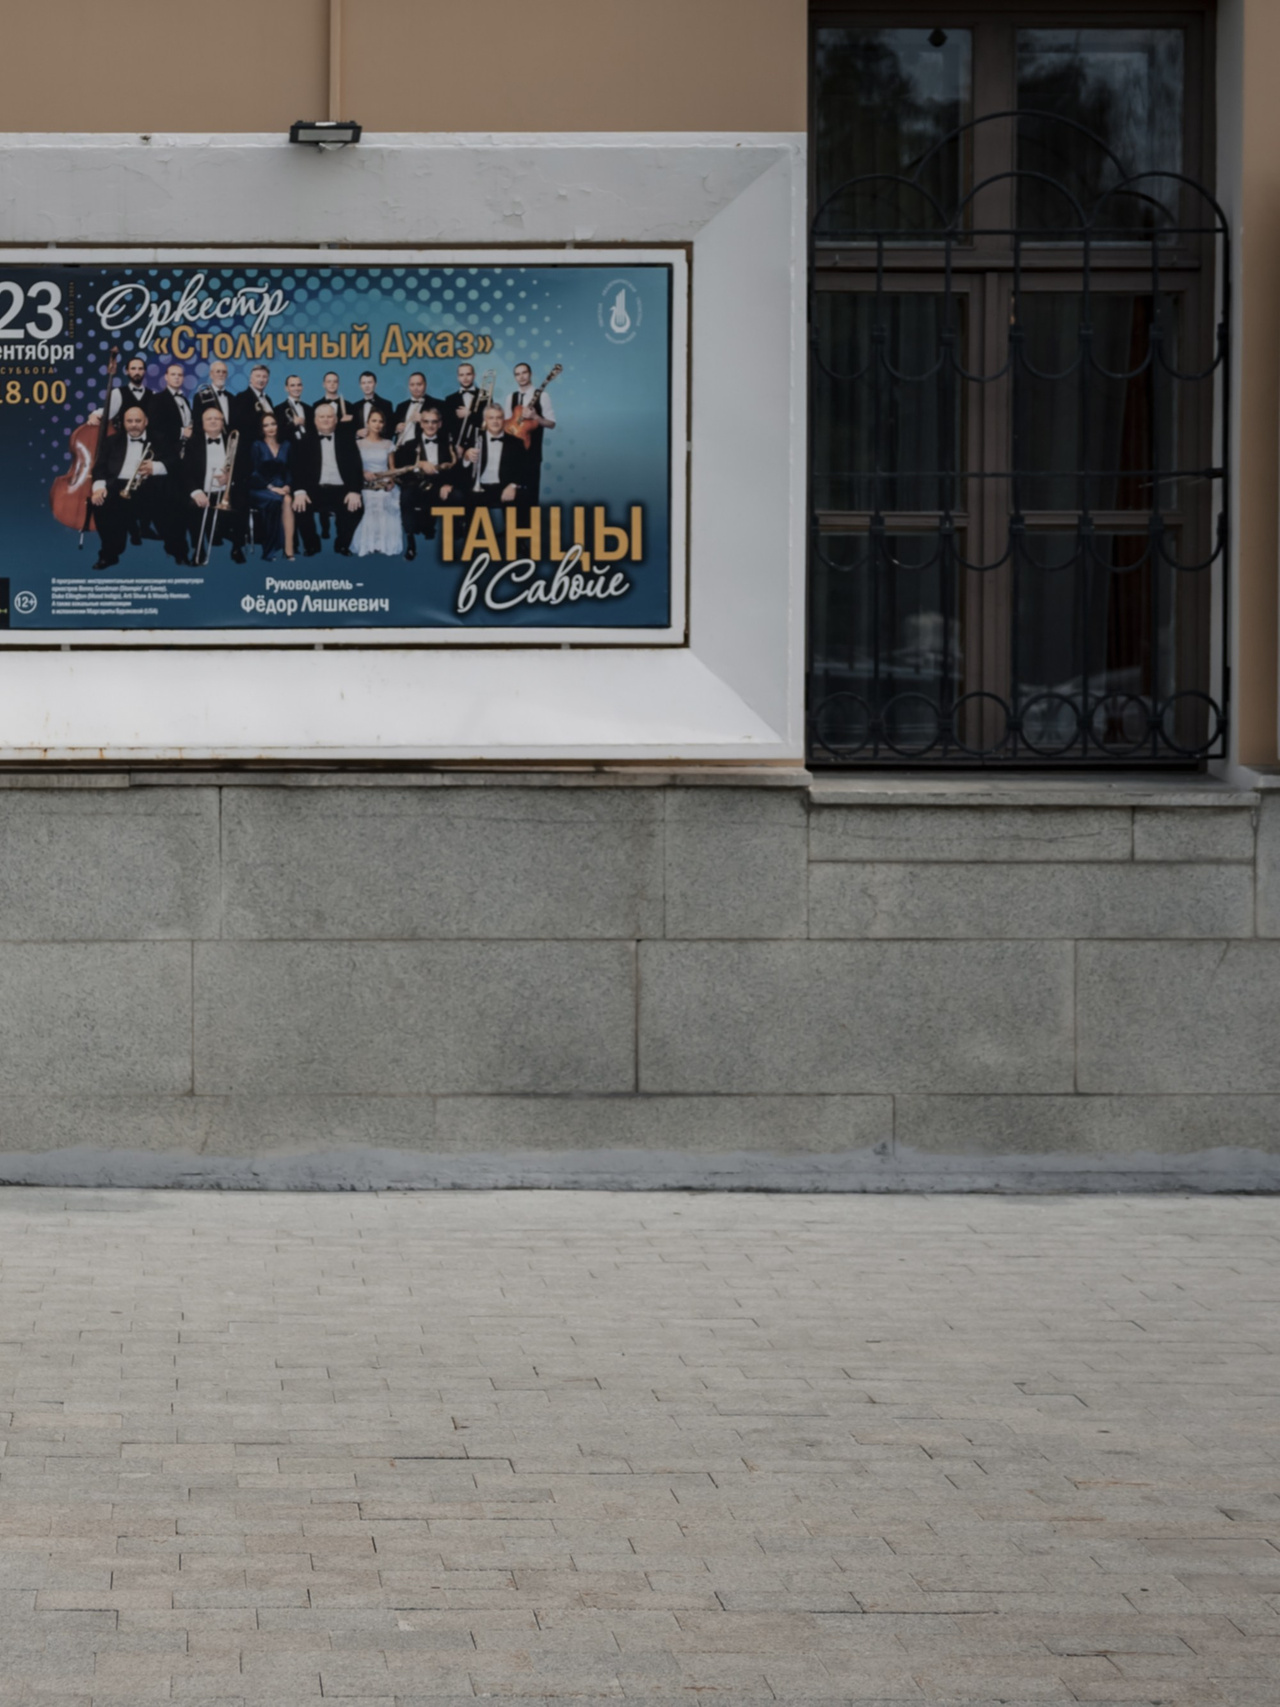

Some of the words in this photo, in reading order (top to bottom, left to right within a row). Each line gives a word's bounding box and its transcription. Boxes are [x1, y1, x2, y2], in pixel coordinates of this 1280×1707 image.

[96, 273, 290, 349] Оркестр
[152, 323, 370, 360] «Столичный
[380, 323, 494, 365] Джаз»
[0, 366, 54, 374] СУББОТА
[431, 506, 642, 572] ТАНЦЫ
[265, 577, 354, 593] Руководитель
[457, 552, 491, 613] в
[484, 544, 630, 610] Савойе
[17, 596, 37, 608] 12+
[240, 594, 299, 616] Фёдор
[300, 594, 390, 613] Ляшкевич
